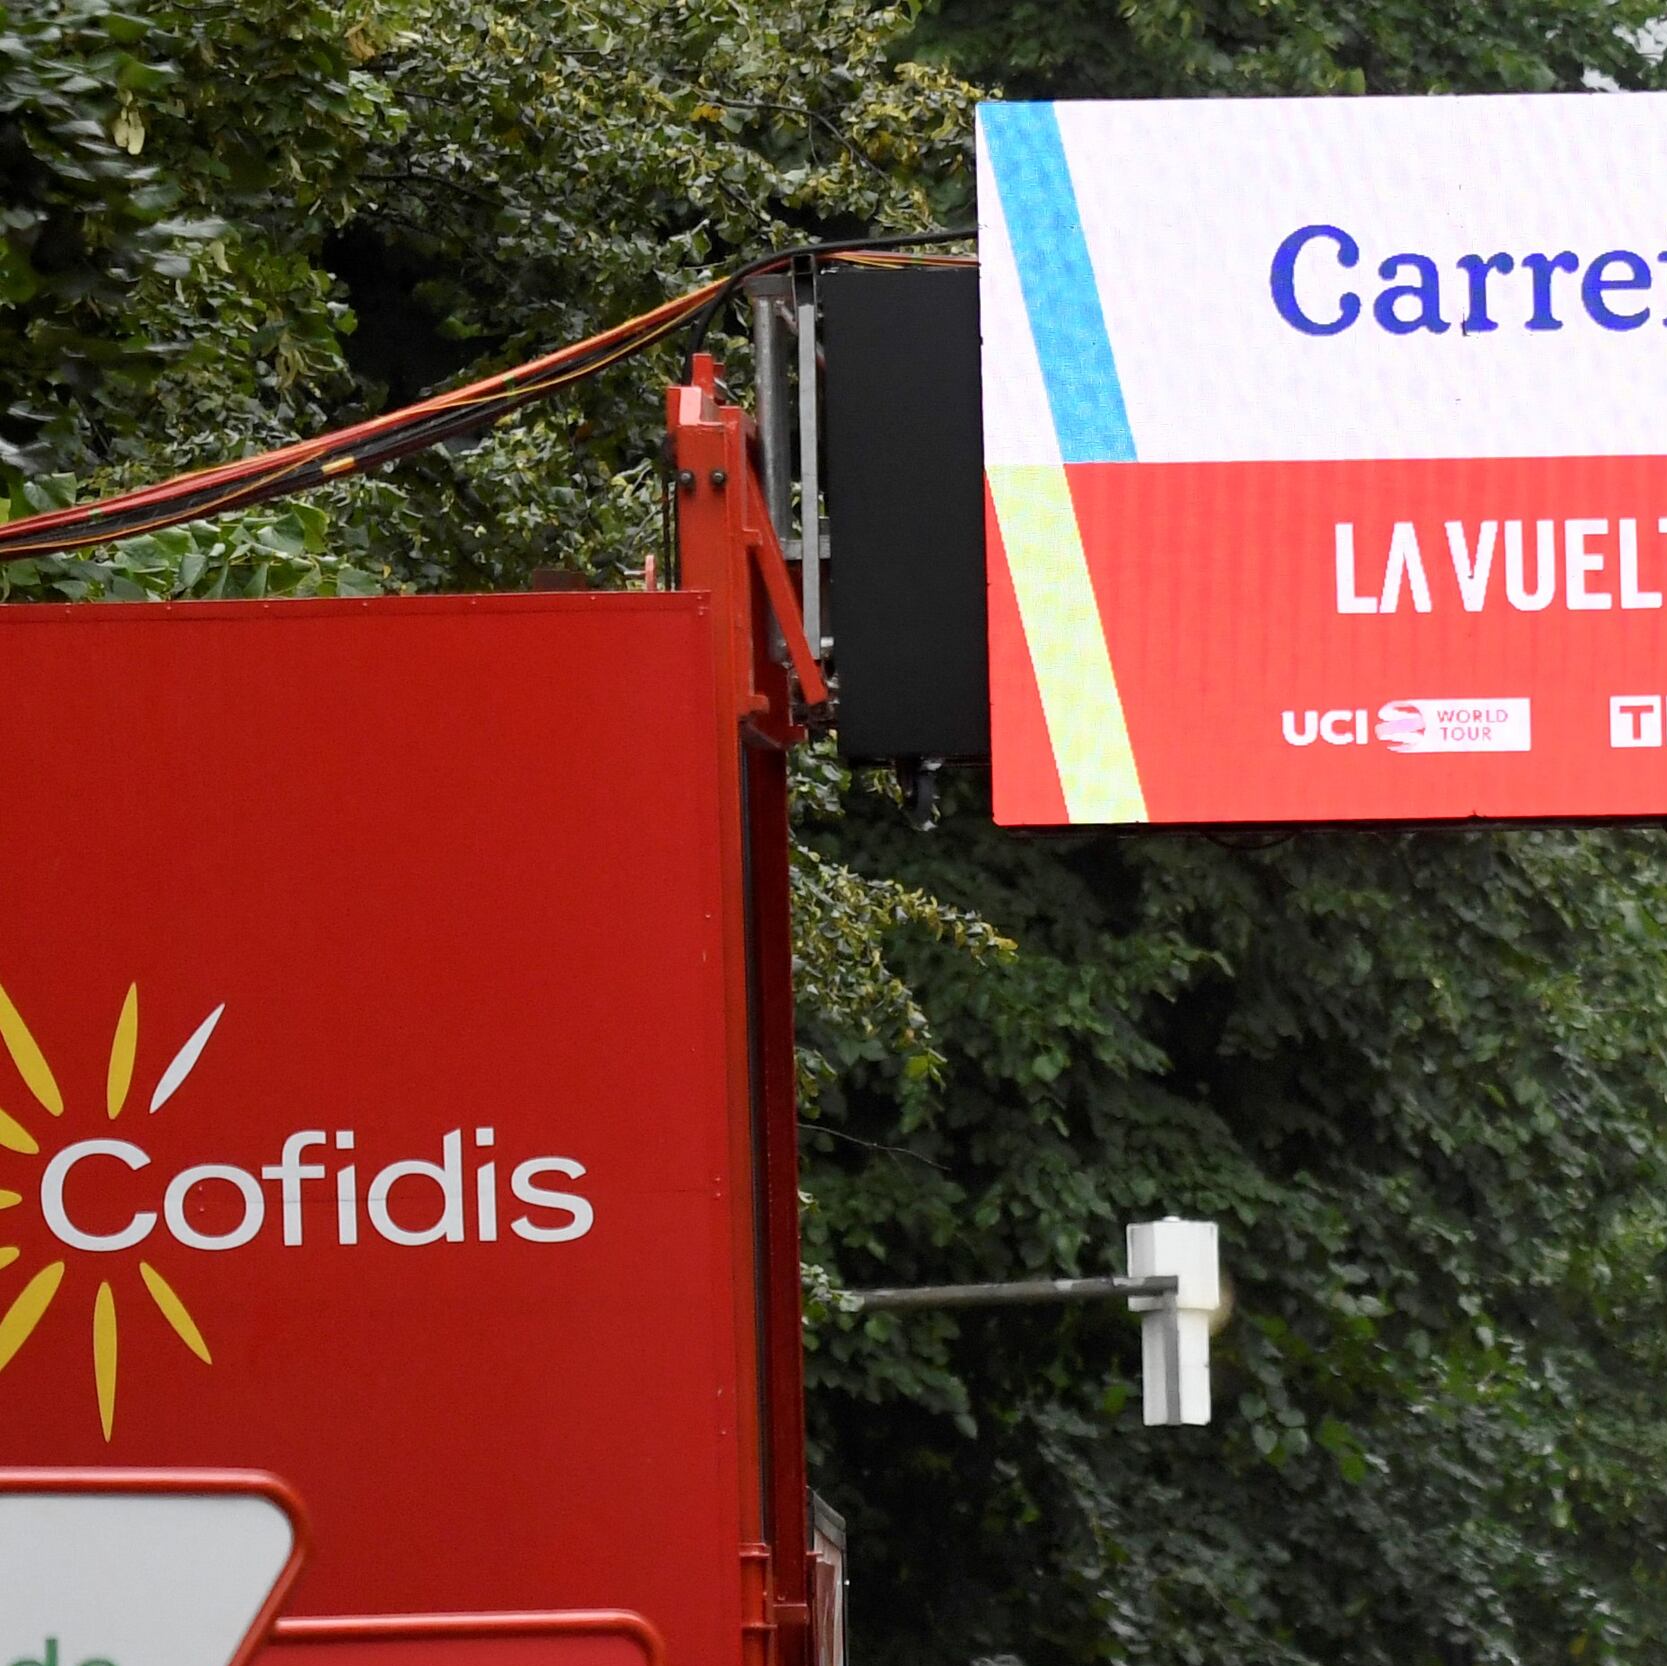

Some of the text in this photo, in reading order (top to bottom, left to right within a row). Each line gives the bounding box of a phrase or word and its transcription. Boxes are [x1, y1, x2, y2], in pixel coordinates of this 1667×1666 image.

[1333, 521, 1432, 615] LA
[1282, 708, 1369, 746] UCI
[1436, 709, 1508, 724] WORLD
[1440, 727, 1492, 741] TOUR
[40, 1127, 594, 1252] Cofidis
